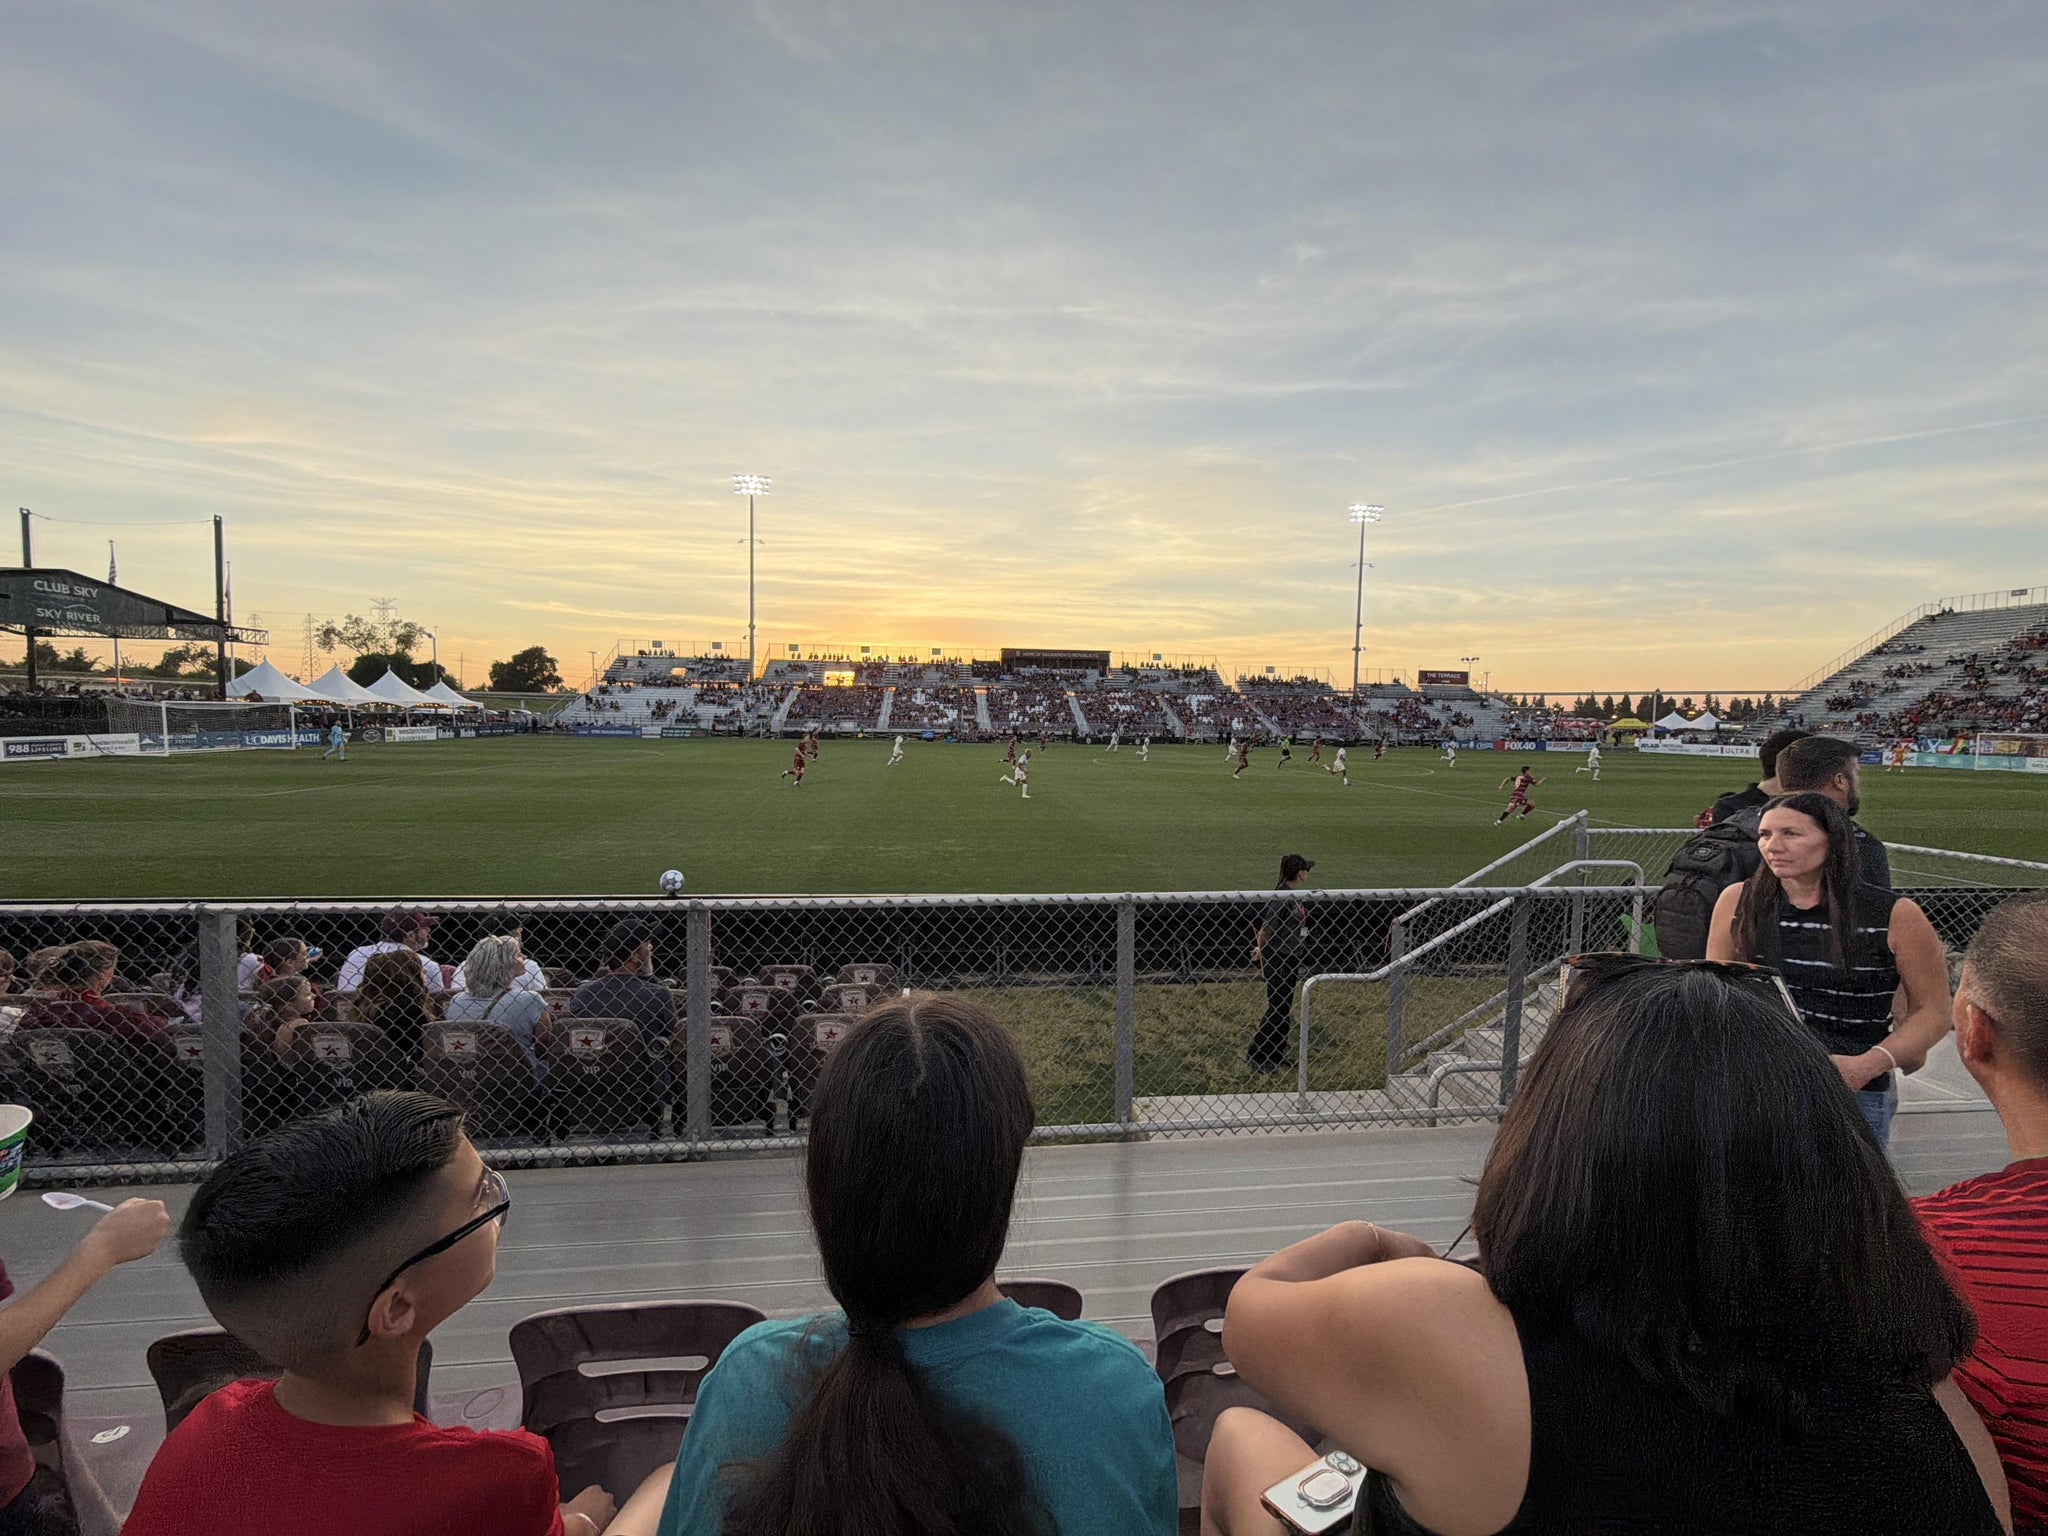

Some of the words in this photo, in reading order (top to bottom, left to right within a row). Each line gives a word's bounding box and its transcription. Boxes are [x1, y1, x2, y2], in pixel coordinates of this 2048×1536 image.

[34, 580, 70, 594] CLUB
[73, 585, 98, 598] SKY
[36, 608, 62, 619] SKY
[66, 612, 102, 624] RIVER
[261, 735, 287, 744] DAVIS
[287, 734, 320, 742] HEALTH
[8, 744, 30, 753] 988
[1505, 742, 1536, 750] FOX40
